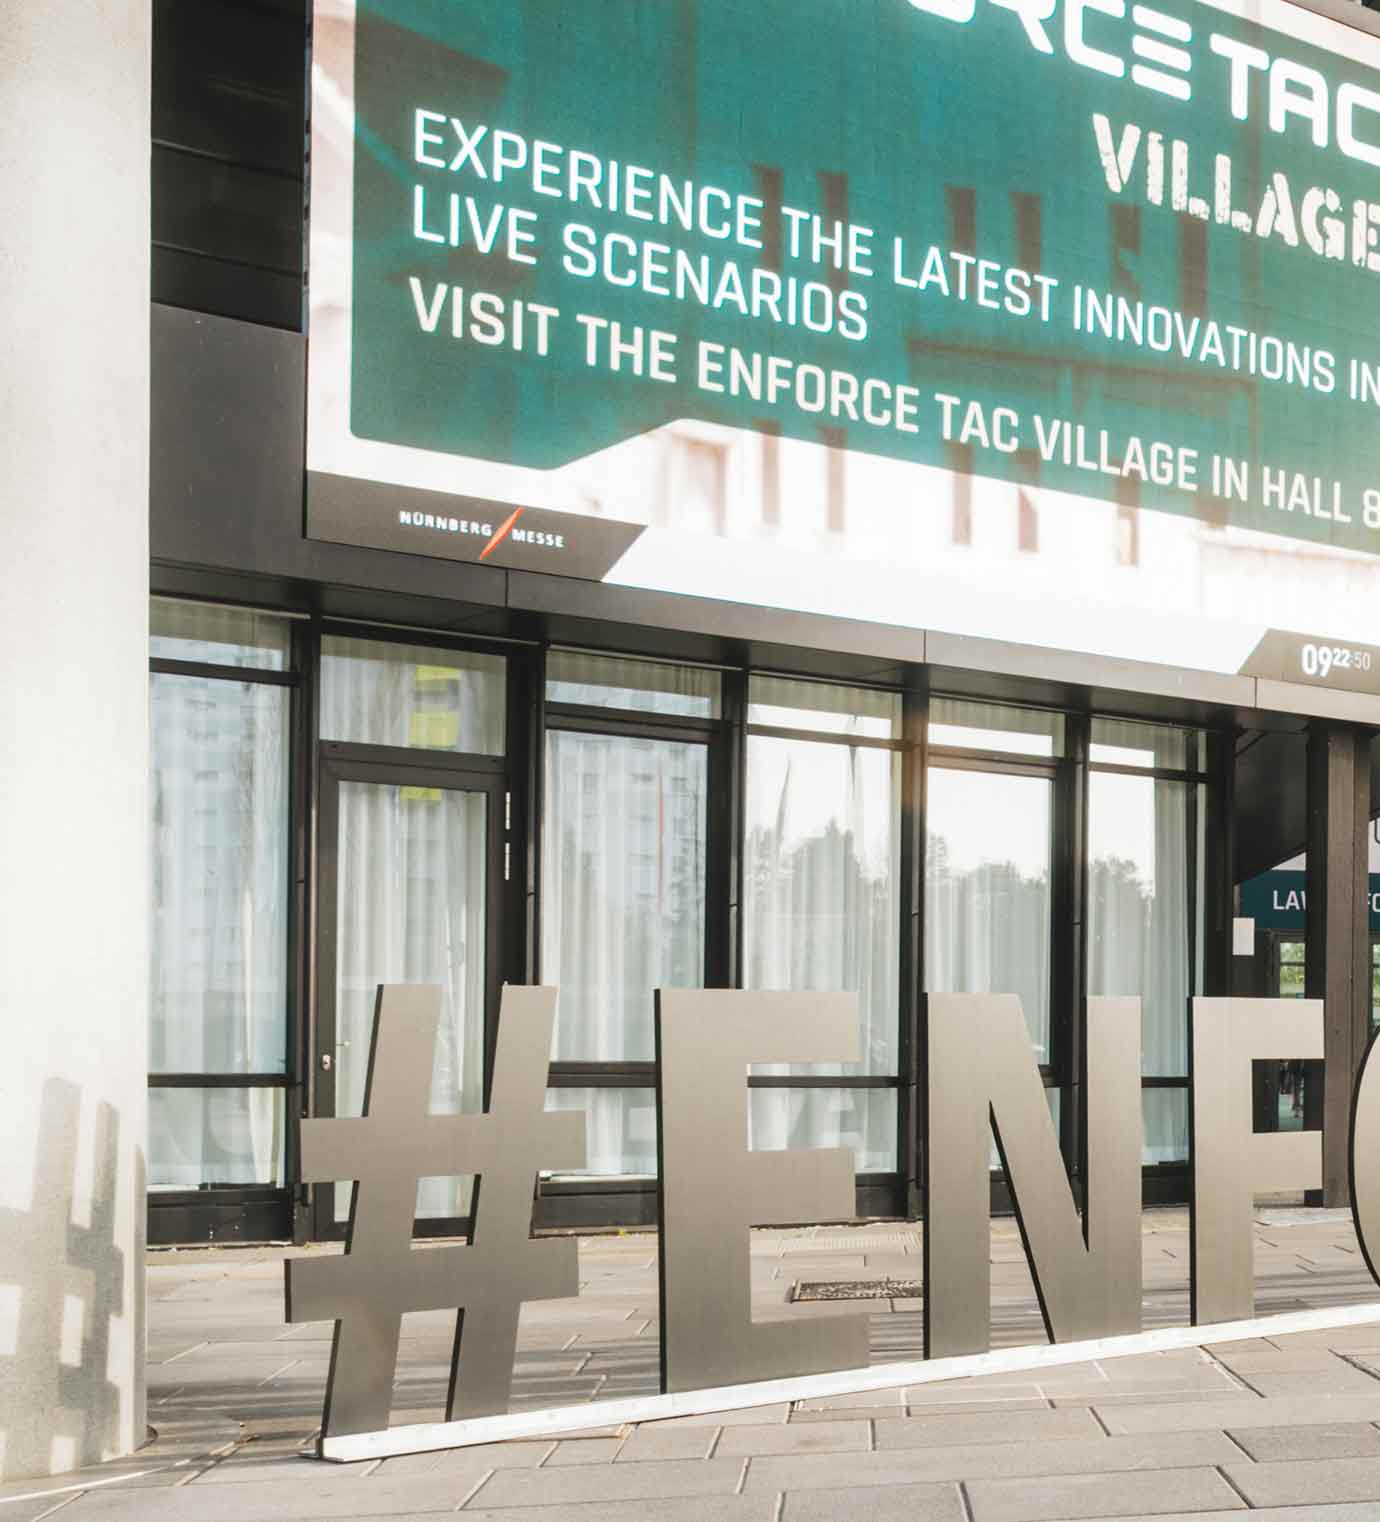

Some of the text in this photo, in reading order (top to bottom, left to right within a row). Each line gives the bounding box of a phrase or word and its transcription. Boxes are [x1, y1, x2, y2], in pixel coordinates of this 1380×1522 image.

[909, 0, 1191, 100] RCE
[414, 185, 867, 340] LIVE SCENARIOS
[415, 109, 763, 249] EXPERIENCE
[781, 207, 874, 276] THE
[894, 237, 1058, 321] LATEST
[1073, 285, 1335, 393] INNOVATIONS
[409, 277, 559, 356] VISIT
[576, 314, 677, 383] THE
[698, 341, 920, 433] ENFORCE
[935, 393, 1019, 453] TAC
[1034, 415, 1199, 492] VILLAGE
[1212, 455, 1249, 503] IN
[1262, 465, 1352, 524] HALL
[399, 510, 565, 548] NÜRNBERG MESSE
[1272, 889, 1306, 911] LA
